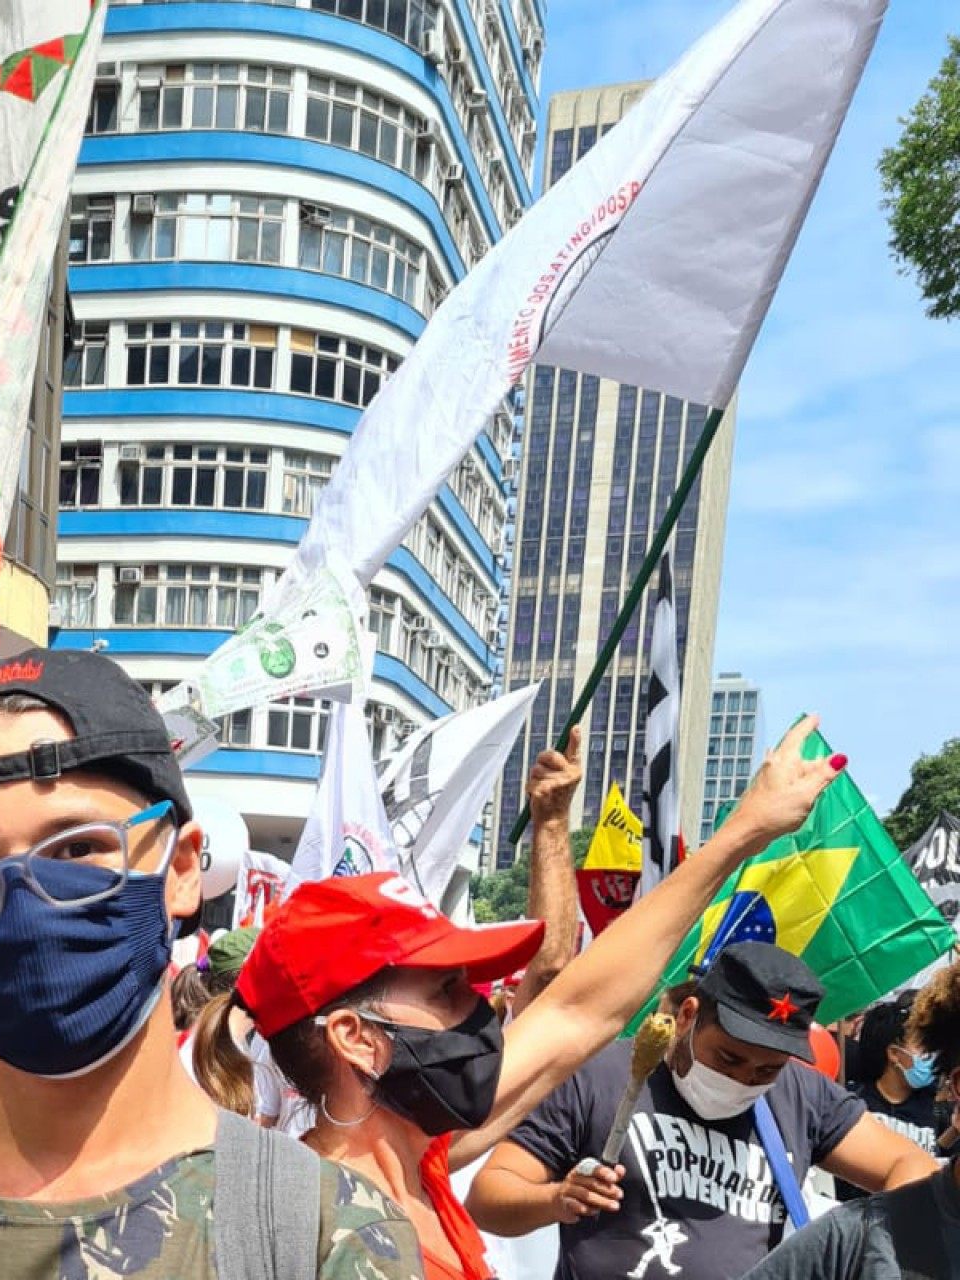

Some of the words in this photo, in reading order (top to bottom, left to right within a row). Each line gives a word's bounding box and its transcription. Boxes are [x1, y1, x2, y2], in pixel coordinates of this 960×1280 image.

[632, 1111, 792, 1184] LEVANT
[649, 1148, 756, 1200] POPULAR
[654, 1170, 786, 1224] JUVENTUDE
